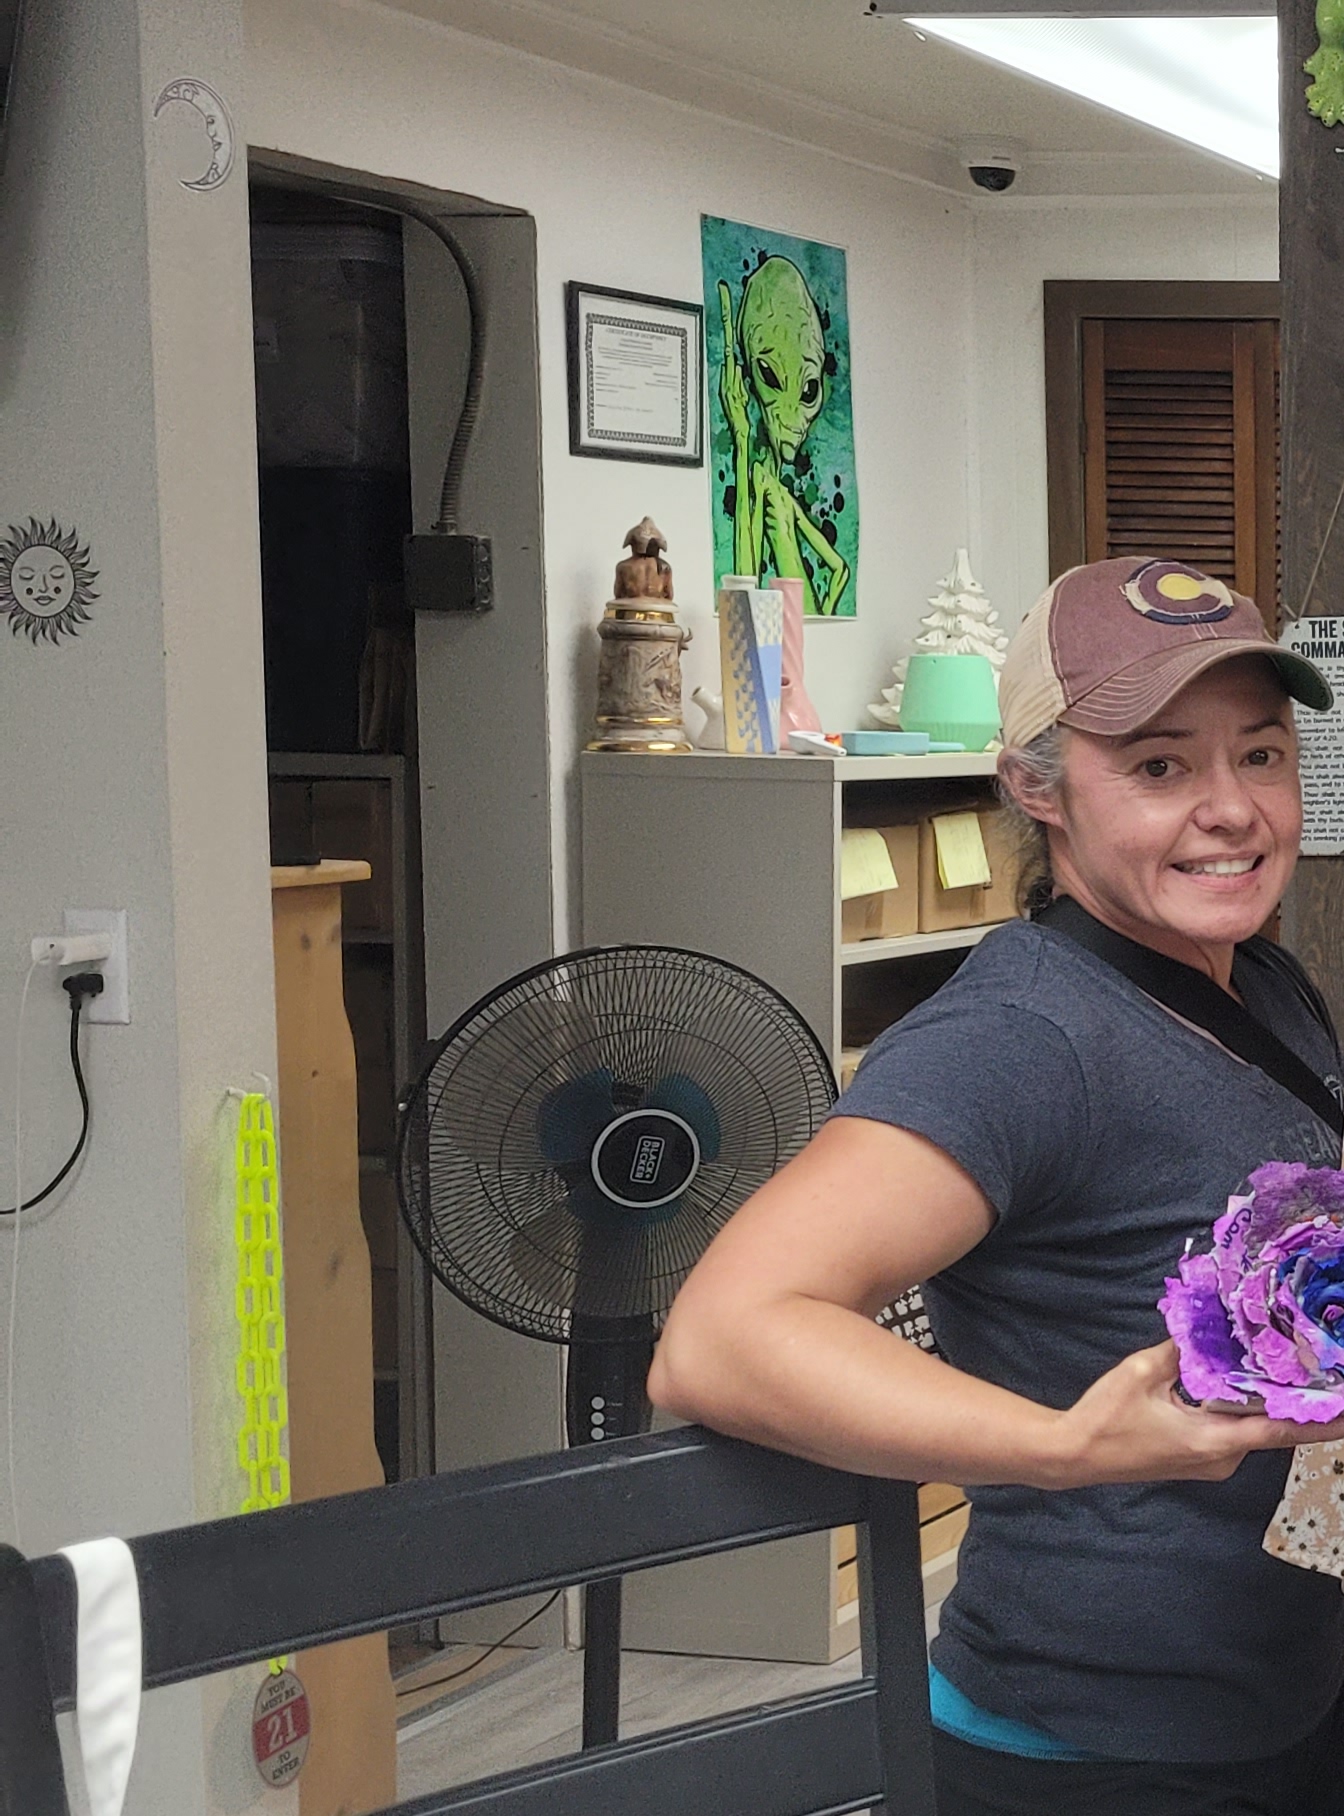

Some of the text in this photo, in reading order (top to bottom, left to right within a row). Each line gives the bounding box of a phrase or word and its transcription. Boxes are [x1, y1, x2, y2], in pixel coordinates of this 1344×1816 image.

[1308, 620, 1338, 639] THE
[268, 1680, 286, 1697] YOU
[261, 1686, 297, 1714] MUST BE
[268, 1705, 298, 1753] 21
[272, 1756, 300, 1780] ENTER
[278, 1751, 291, 1764] TO
